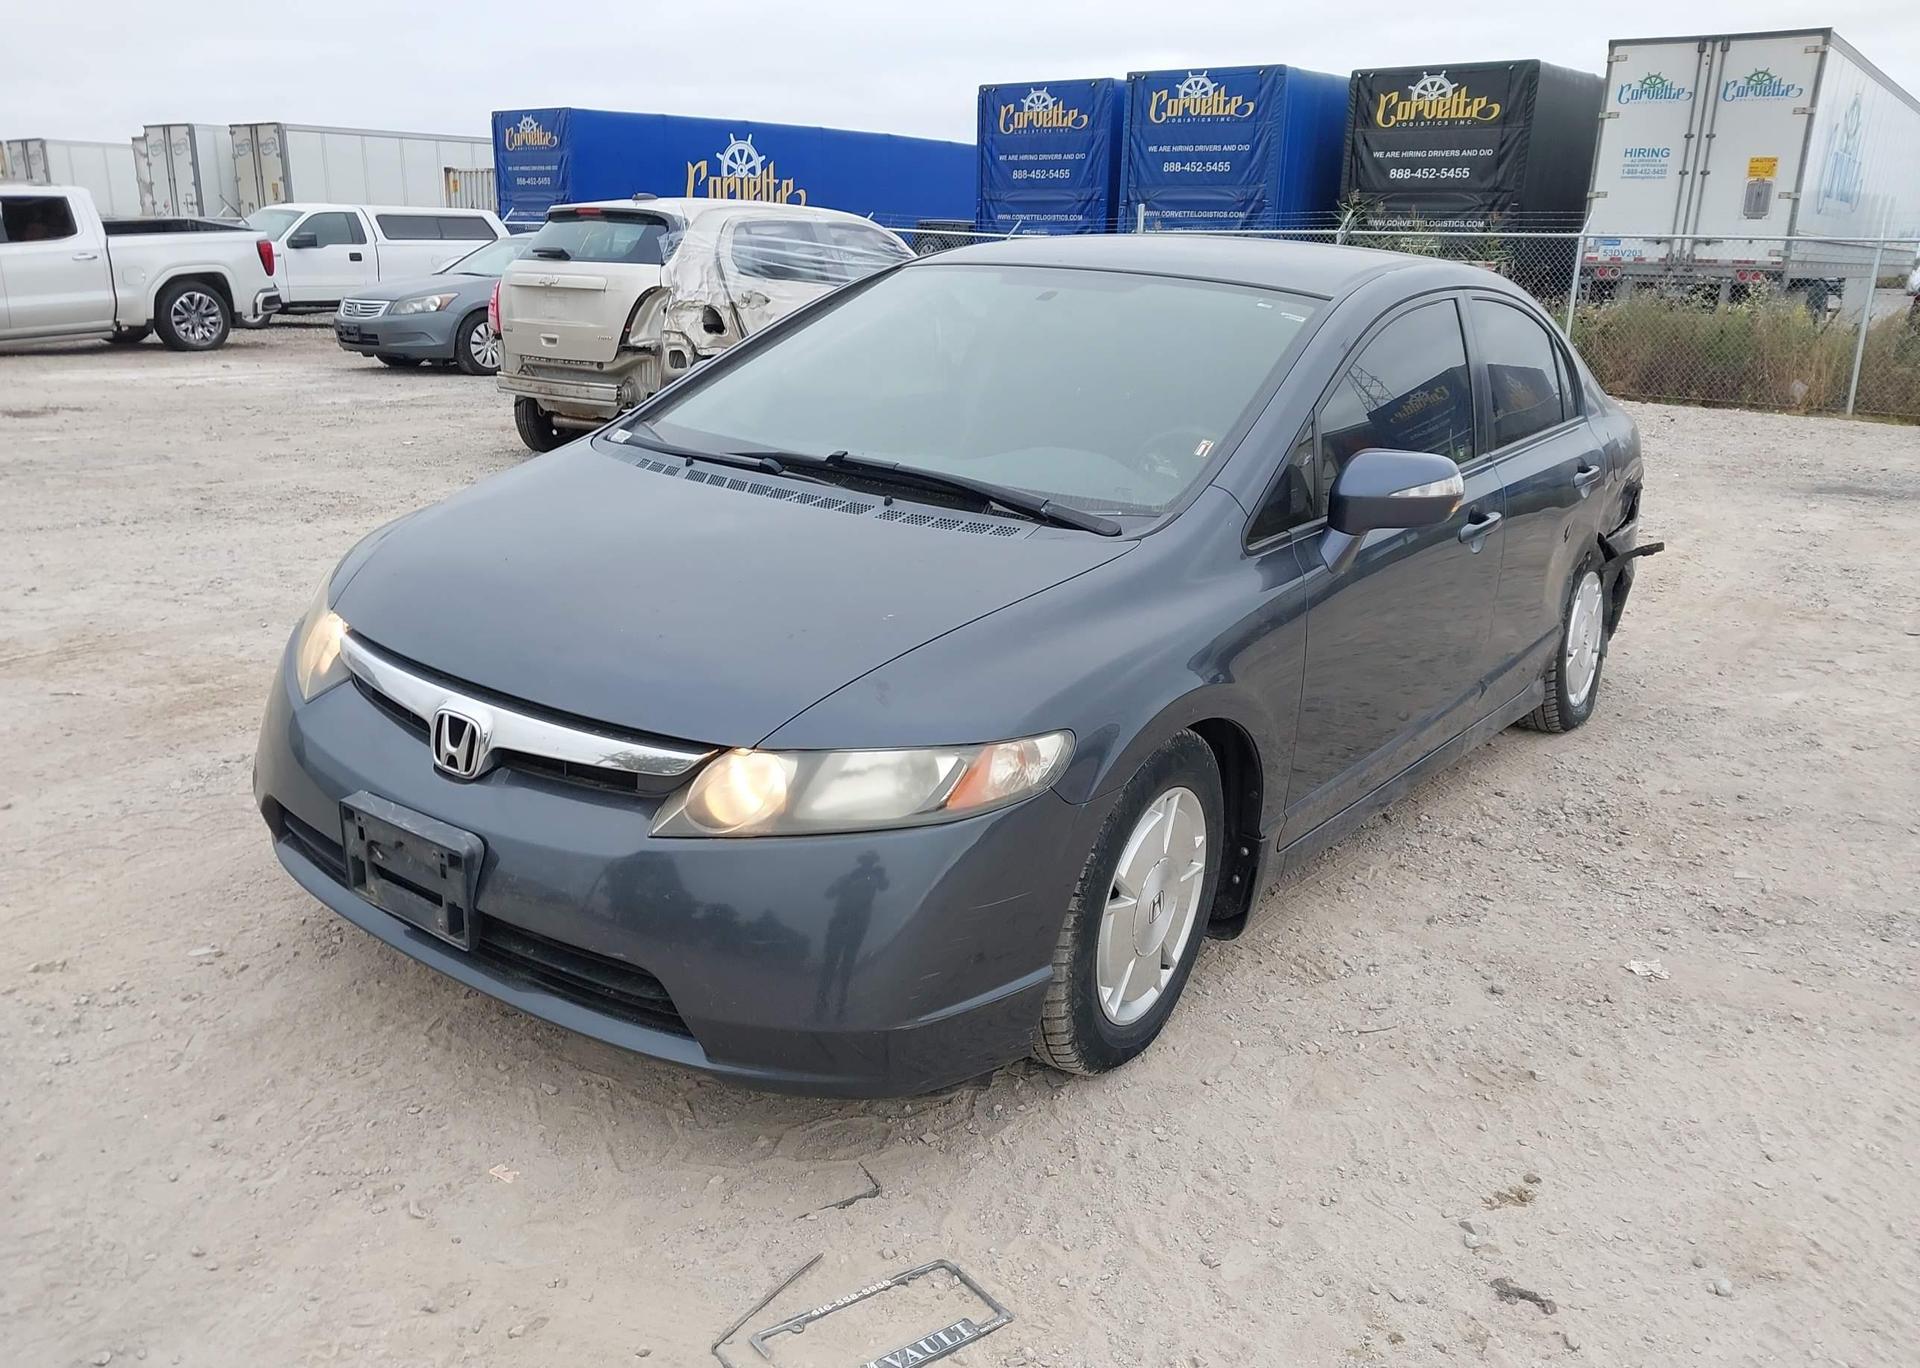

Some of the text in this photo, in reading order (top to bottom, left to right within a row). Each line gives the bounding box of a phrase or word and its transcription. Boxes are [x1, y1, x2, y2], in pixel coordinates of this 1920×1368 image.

[1150, 85, 1254, 123] Corvette
[1376, 85, 1500, 127] Corvette
[999, 98, 1088, 134] Corvette
[1194, 144, 1221, 152] DRIVERS
[1401, 150, 1427, 158] HIRING
[1428, 149, 1460, 157] DRIVERS
[1624, 148, 1670, 158] HIRING
[1163, 161, 1230, 172] 888-452-5455
[1012, 169, 1071, 179] 888-452-5455
[1389, 167, 1470, 179] 888-452-5455
[884, 1320, 971, 1368] VAULT
